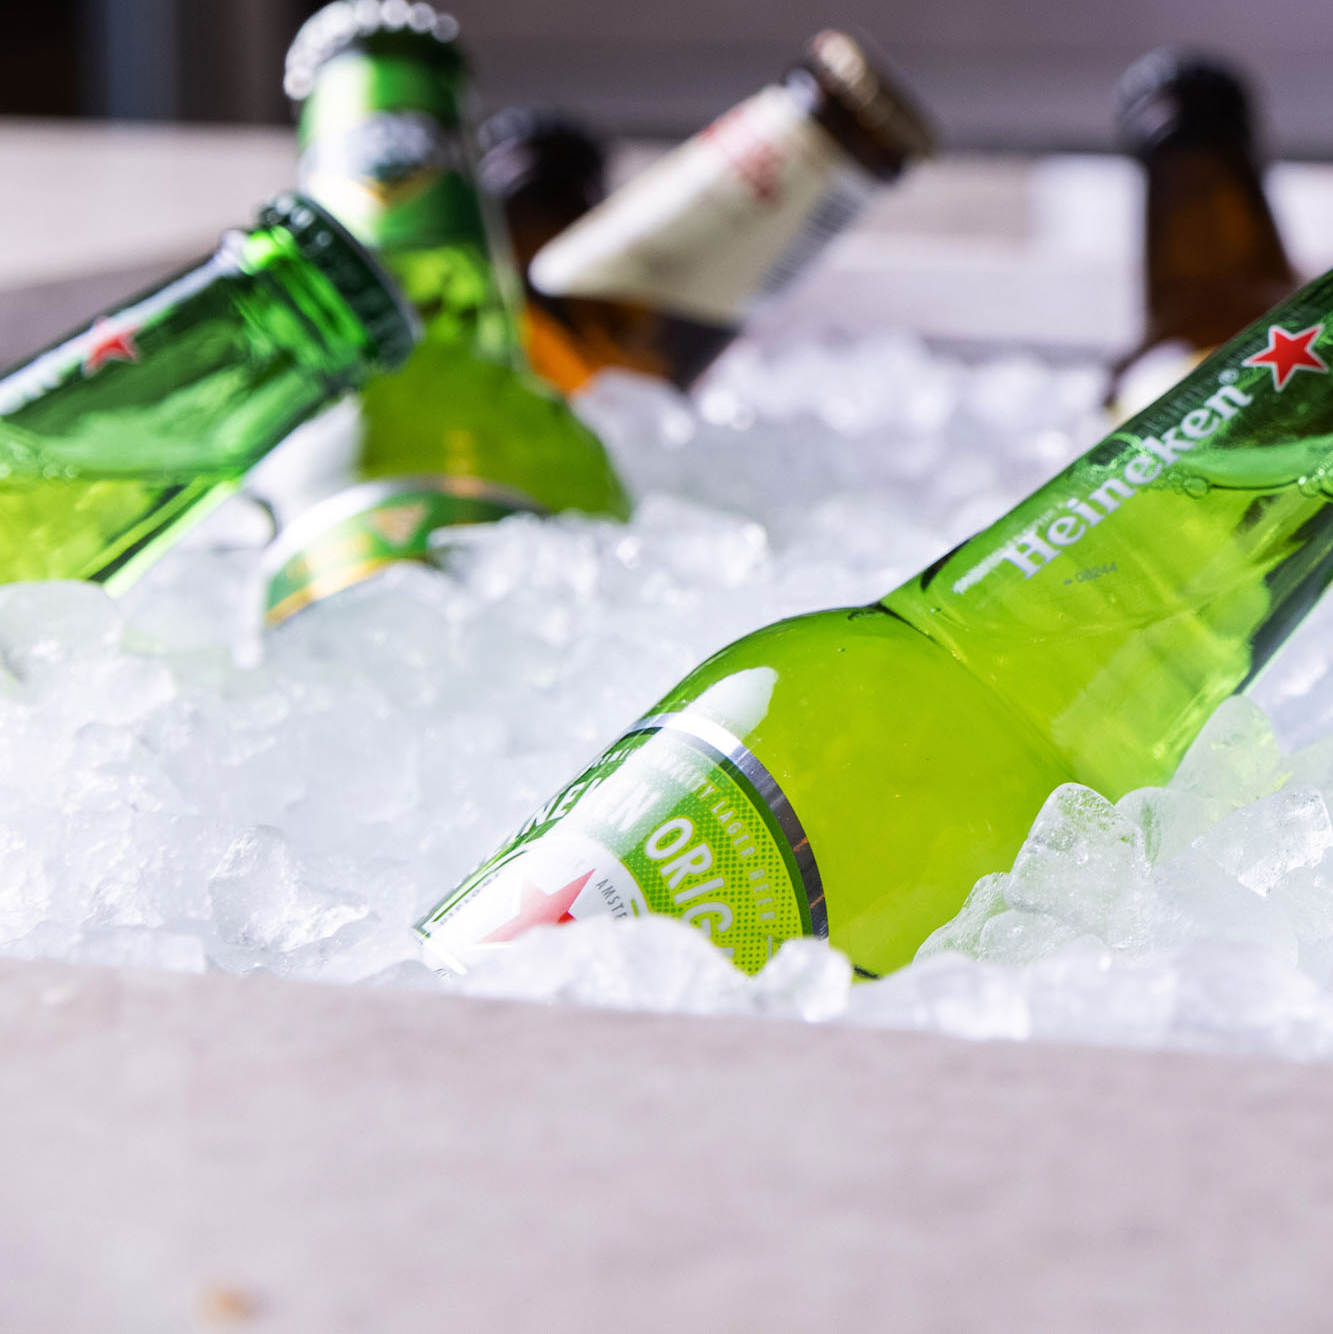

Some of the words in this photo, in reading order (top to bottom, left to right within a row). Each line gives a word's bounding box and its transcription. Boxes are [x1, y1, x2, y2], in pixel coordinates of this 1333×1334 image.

[645, 816, 734, 956] ORIG
[711, 800, 755, 861] LAGER
[749, 869, 776, 922] BEER
